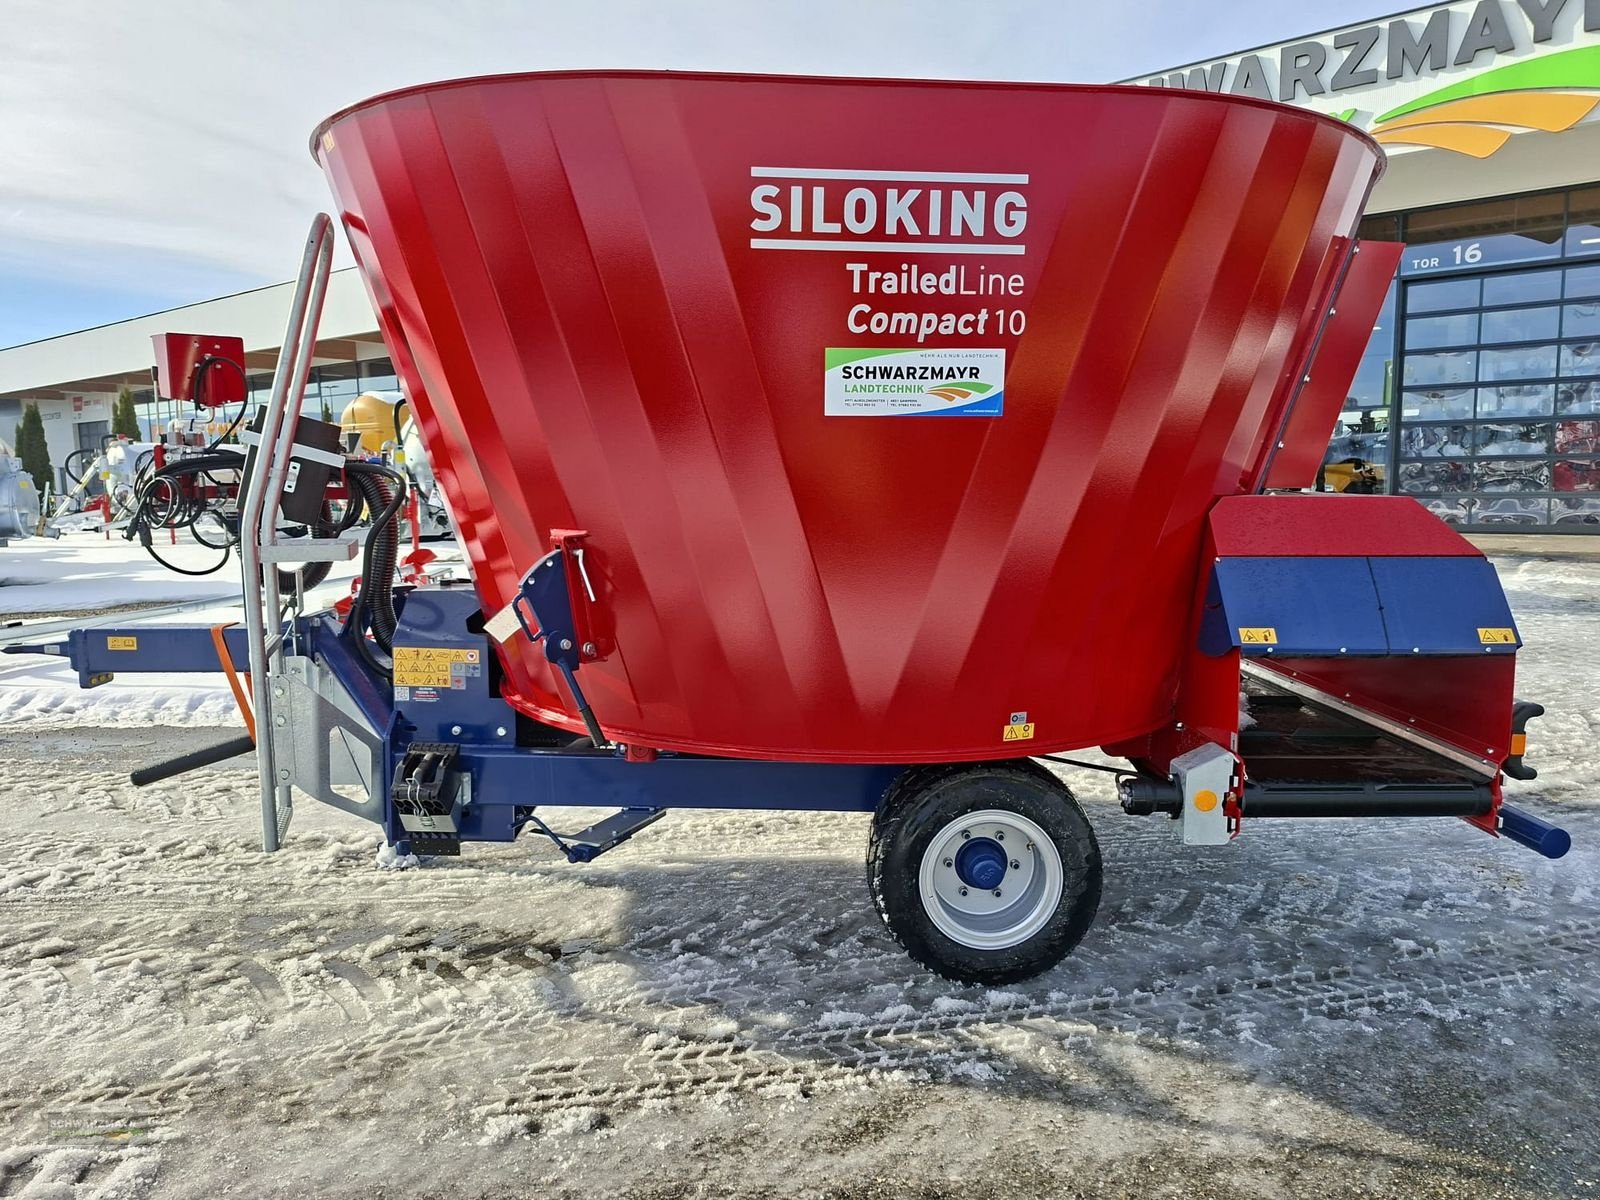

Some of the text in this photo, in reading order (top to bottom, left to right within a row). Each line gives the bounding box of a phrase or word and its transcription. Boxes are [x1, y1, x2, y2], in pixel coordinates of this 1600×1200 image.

[750, 184, 1028, 238] SILOKING
[1412, 243, 1482, 269] TOR 16
[846, 263, 1024, 296] TrailedLine
[846, 304, 1026, 343] Compact 10
[842, 366, 980, 380] SCHWARZMAYR
[844, 384, 925, 393] LANDTECHNIK
